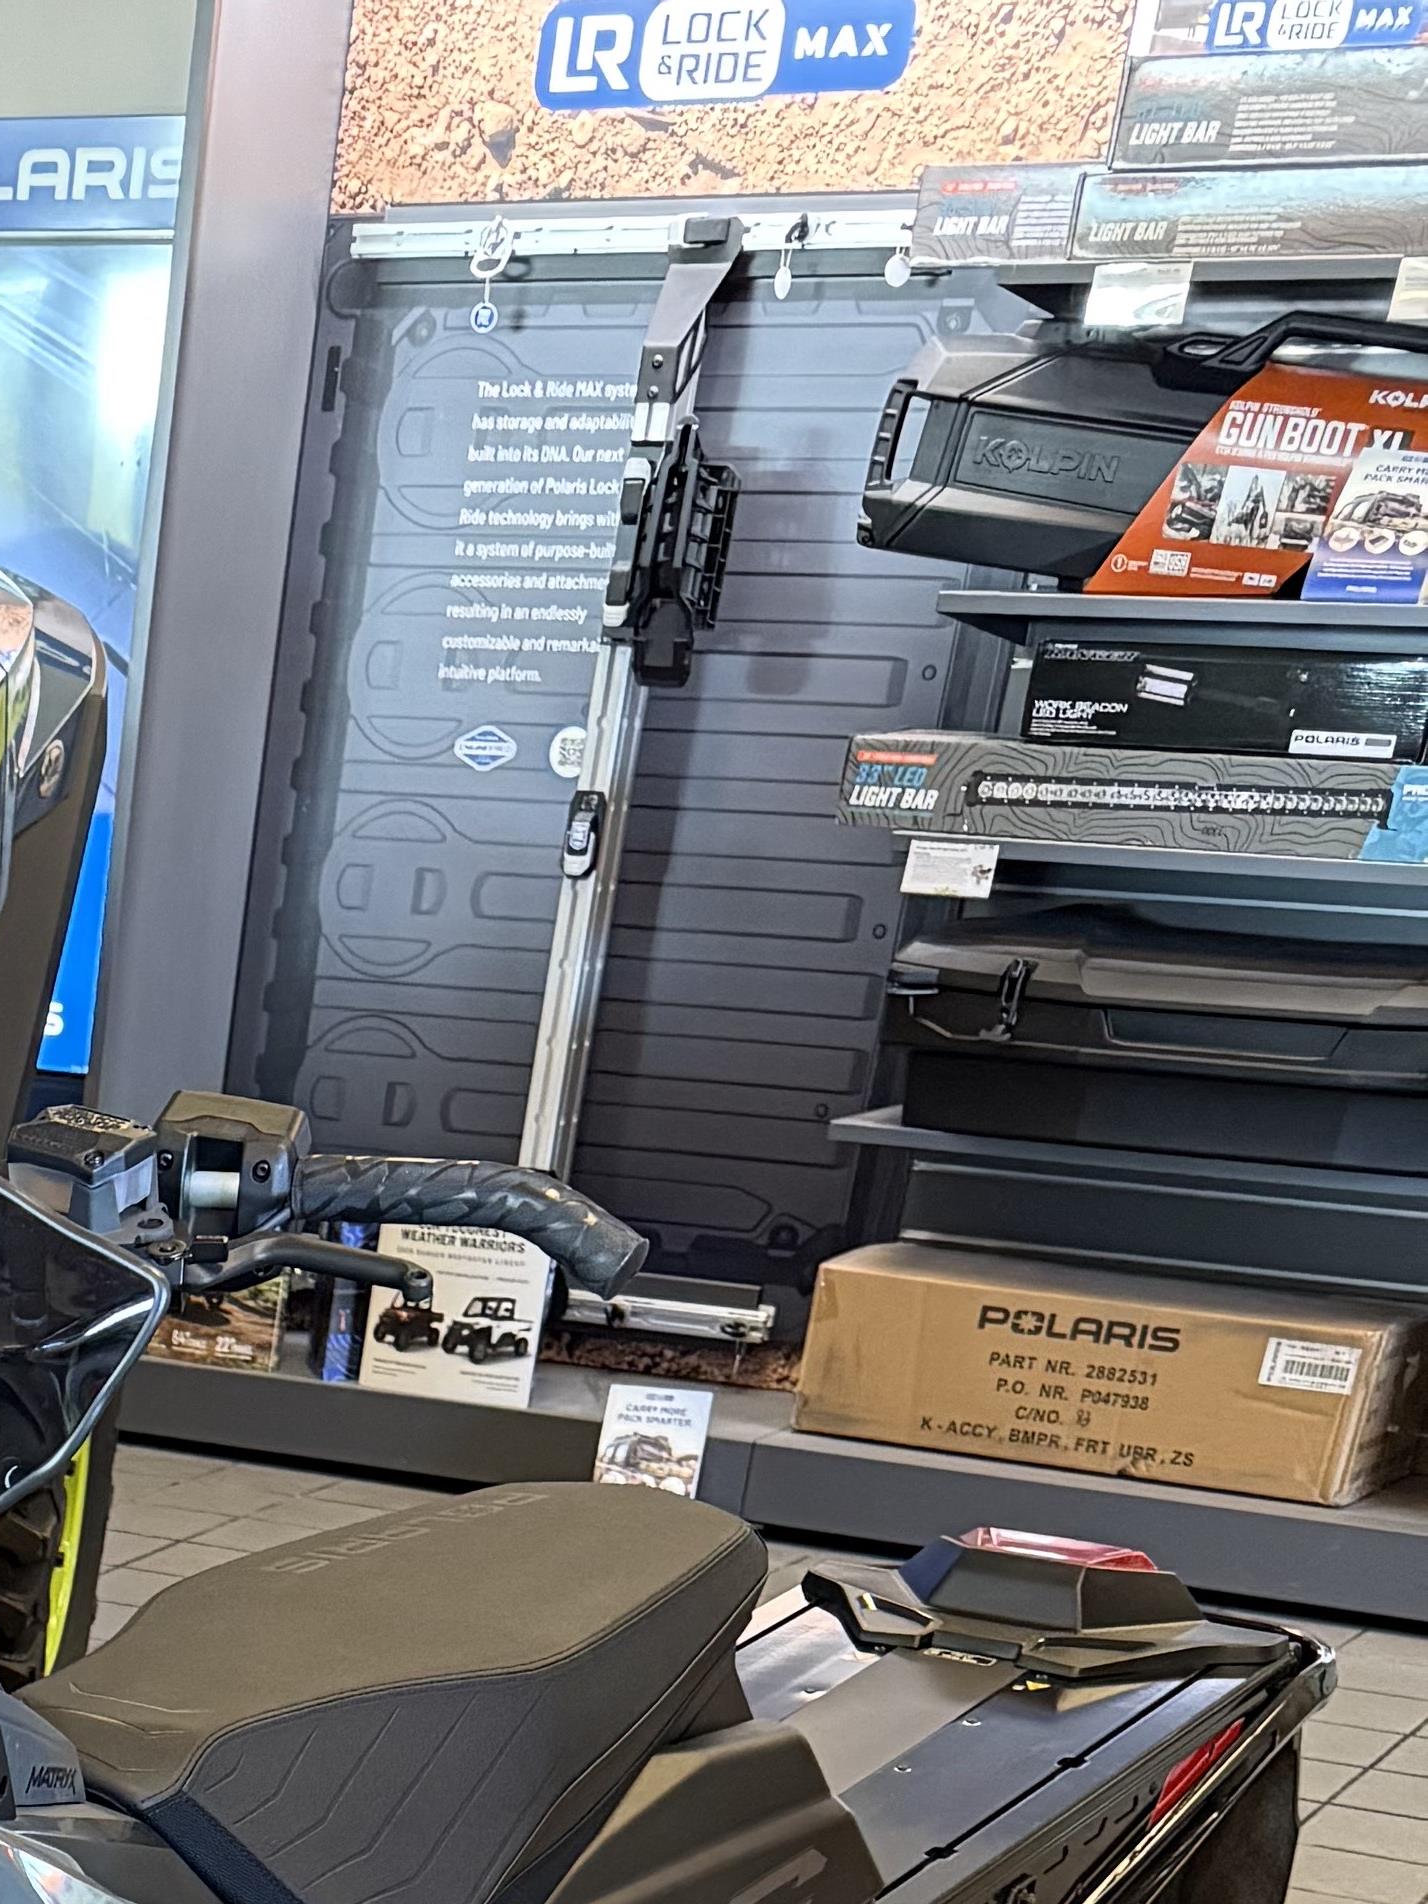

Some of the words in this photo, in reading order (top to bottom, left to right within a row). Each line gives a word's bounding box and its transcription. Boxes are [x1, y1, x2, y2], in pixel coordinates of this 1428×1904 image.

[661, 8, 770, 45] LOCK
[1353, 5, 1414, 33] MAX
[793, 23, 894, 60] MAX
[1129, 120, 1184, 146] LIGHT
[1180, 120, 1222, 144] BAR
[932, 216, 978, 236] LIGHT
[975, 215, 1010, 235] BAR
[1089, 222, 1136, 242] LIGHT
[1133, 221, 1168, 241] BAR
[478, 380, 501, 399] The
[502, 381, 532, 398] Lock
[534, 381, 544, 398] &
[546, 381, 573, 398] Ride
[576, 381, 604, 398] MAX
[604, 382, 637, 401] syste
[472, 414, 494, 431] has
[496, 414, 543, 433] storage
[544, 414, 568, 430] and
[569, 413, 634, 432] adaptabilit
[1218, 411, 1284, 449] GUN
[1281, 417, 1369, 457] BOOT
[468, 445, 496, 463] built
[497, 445, 522, 462] into
[523, 445, 540, 463] its
[572, 446, 595, 463] Our
[596, 447, 624, 463] next
[972, 436, 1120, 484] KOLPIN
[464, 479, 529, 497] generation
[530, 478, 543, 495] of
[545, 478, 587, 495] Polaris
[459, 508, 486, 526] Ride
[488, 509, 554, 529] technology
[556, 510, 594, 529] brings
[455, 540, 465, 557] it
[466, 543, 475, 557] a
[476, 541, 519, 560] system
[521, 541, 535, 557] of
[450, 572, 521, 589] accessories
[523, 572, 545, 589] and
[548, 573, 610, 590] attachme
[447, 604, 498, 622] resulting
[502, 604, 512, 620] in
[514, 606, 529, 620] an
[531, 605, 587, 625] endlessly
[442, 635, 520, 651] customizable
[522, 636, 545, 651] and
[547, 637, 601, 653] remarka
[438, 664, 486, 680] intuitive
[1294, 733, 1362, 747] POLARIS
[895, 766, 928, 787] LED
[849, 785, 901, 808] LIGHT
[900, 788, 939, 810] BAR
[401, 1229, 457, 1246] WEATHER
[460, 1236, 526, 1254] WARRIORS
[977, 1304, 1181, 1353] POLARIS
[988, 1350, 1038, 1371] PART
[1045, 1359, 1076, 1377] NR.
[1085, 1364, 1159, 1387] 2882531
[1039, 1383, 1069, 1402] NR.
[1074, 1437, 1111, 1455] FRT
